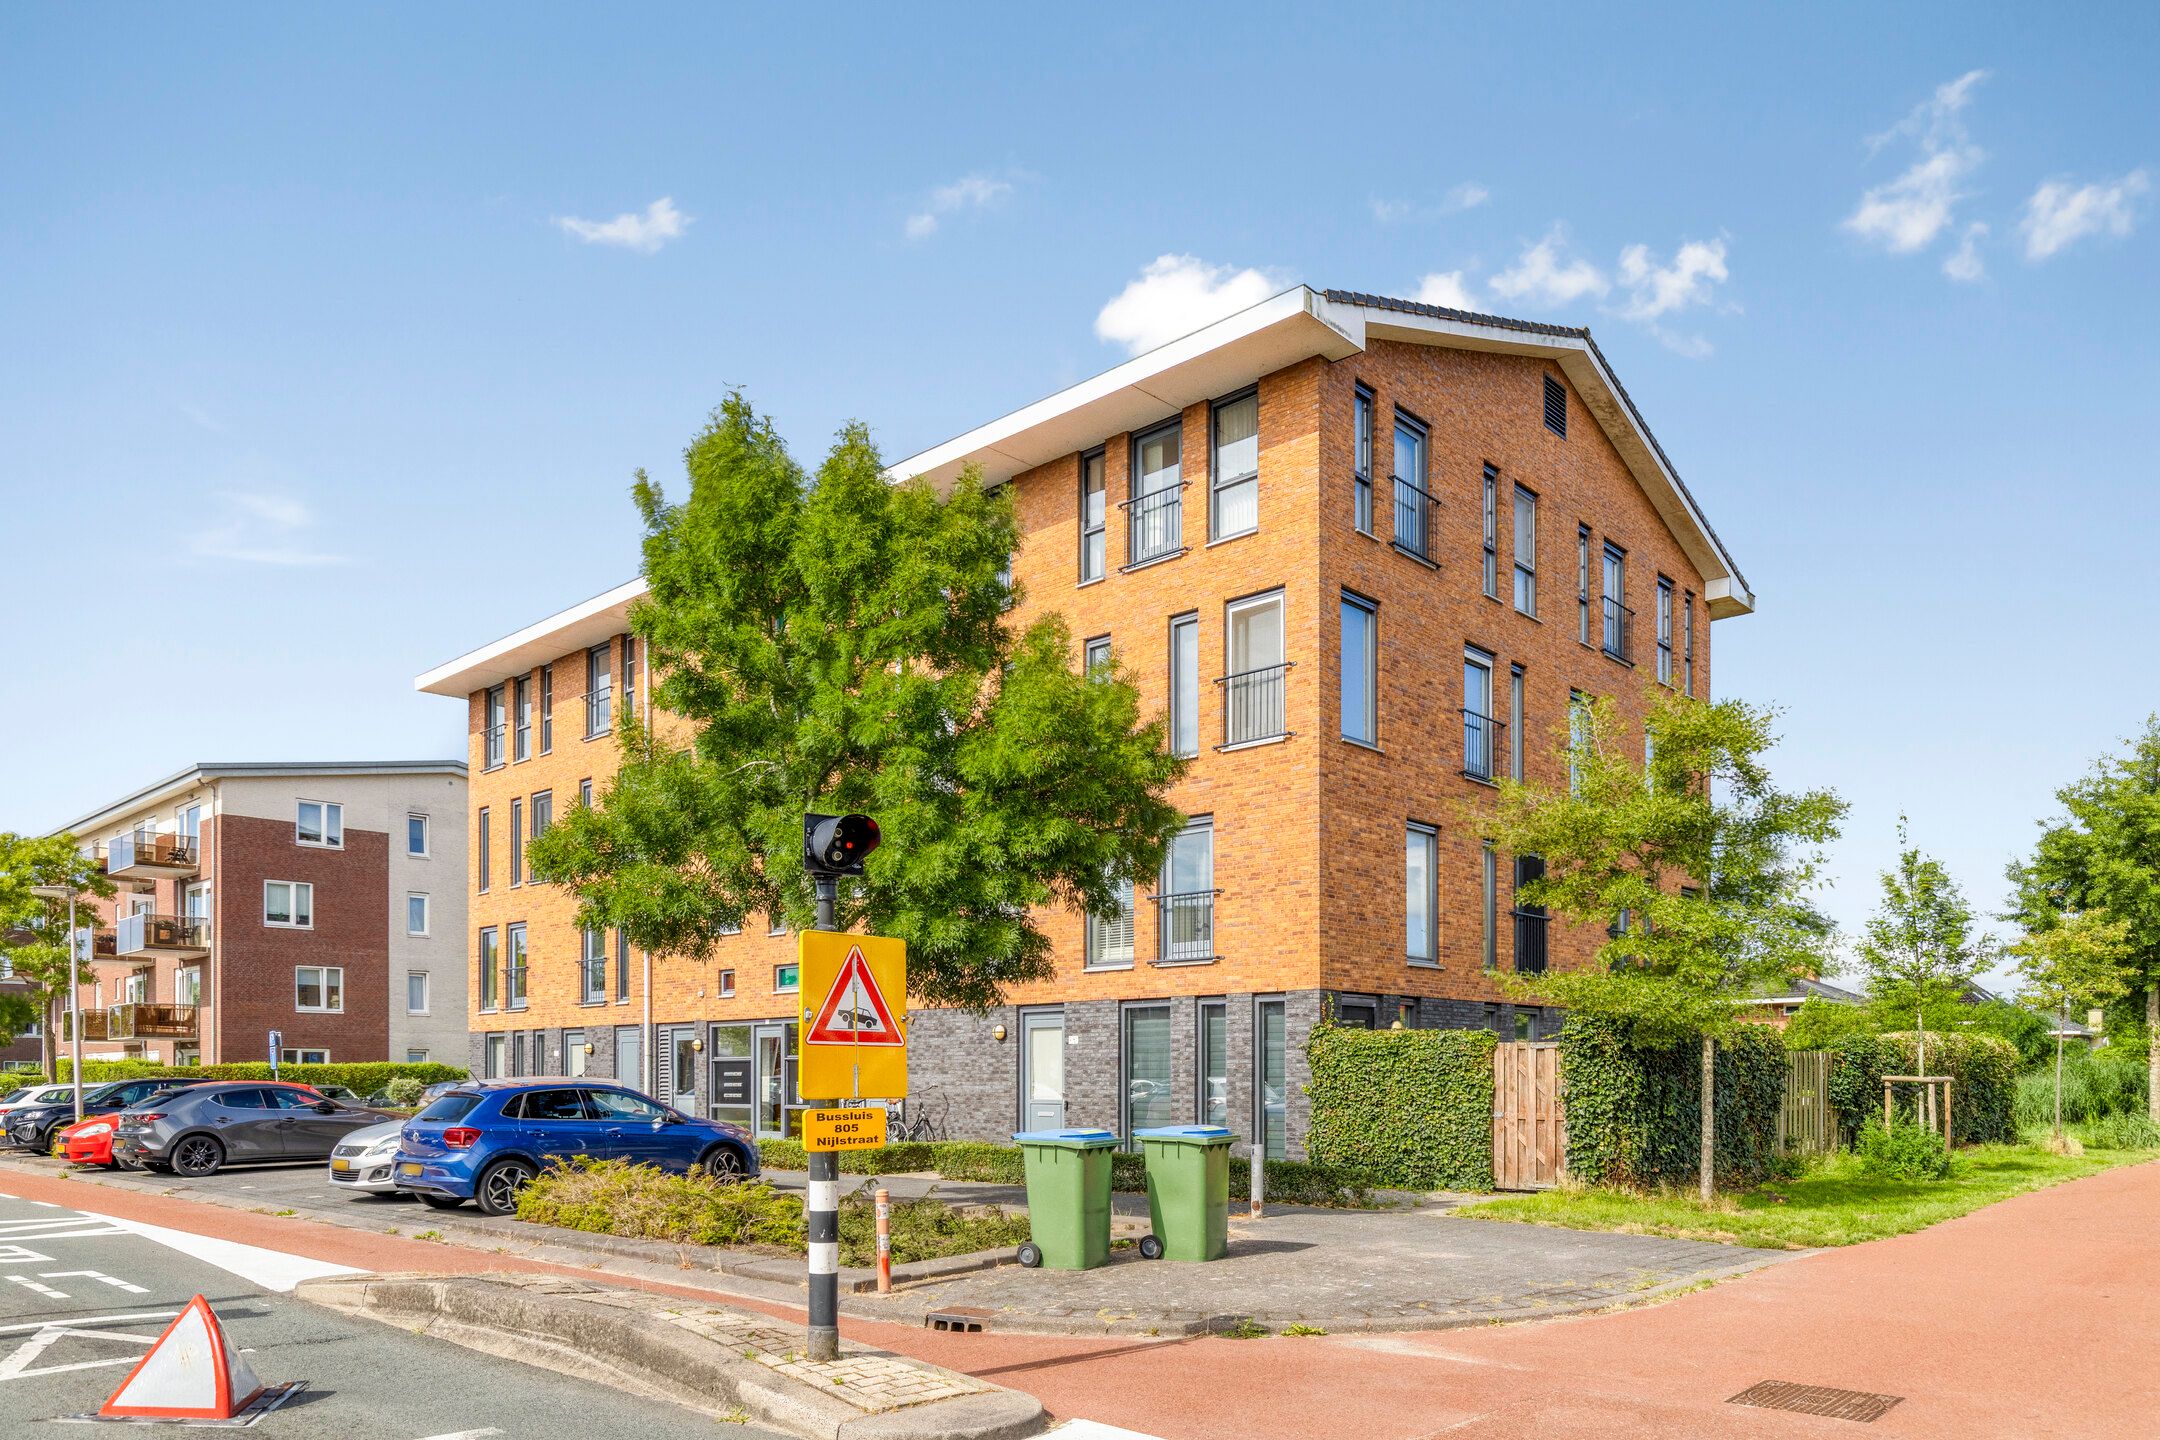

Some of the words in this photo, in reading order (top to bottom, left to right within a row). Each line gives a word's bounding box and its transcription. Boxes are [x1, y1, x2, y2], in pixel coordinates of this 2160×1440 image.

[816, 1111, 873, 1122] Bussluis
[834, 1124, 859, 1133] 805
[816, 1135, 879, 1148] Nijlstraat
